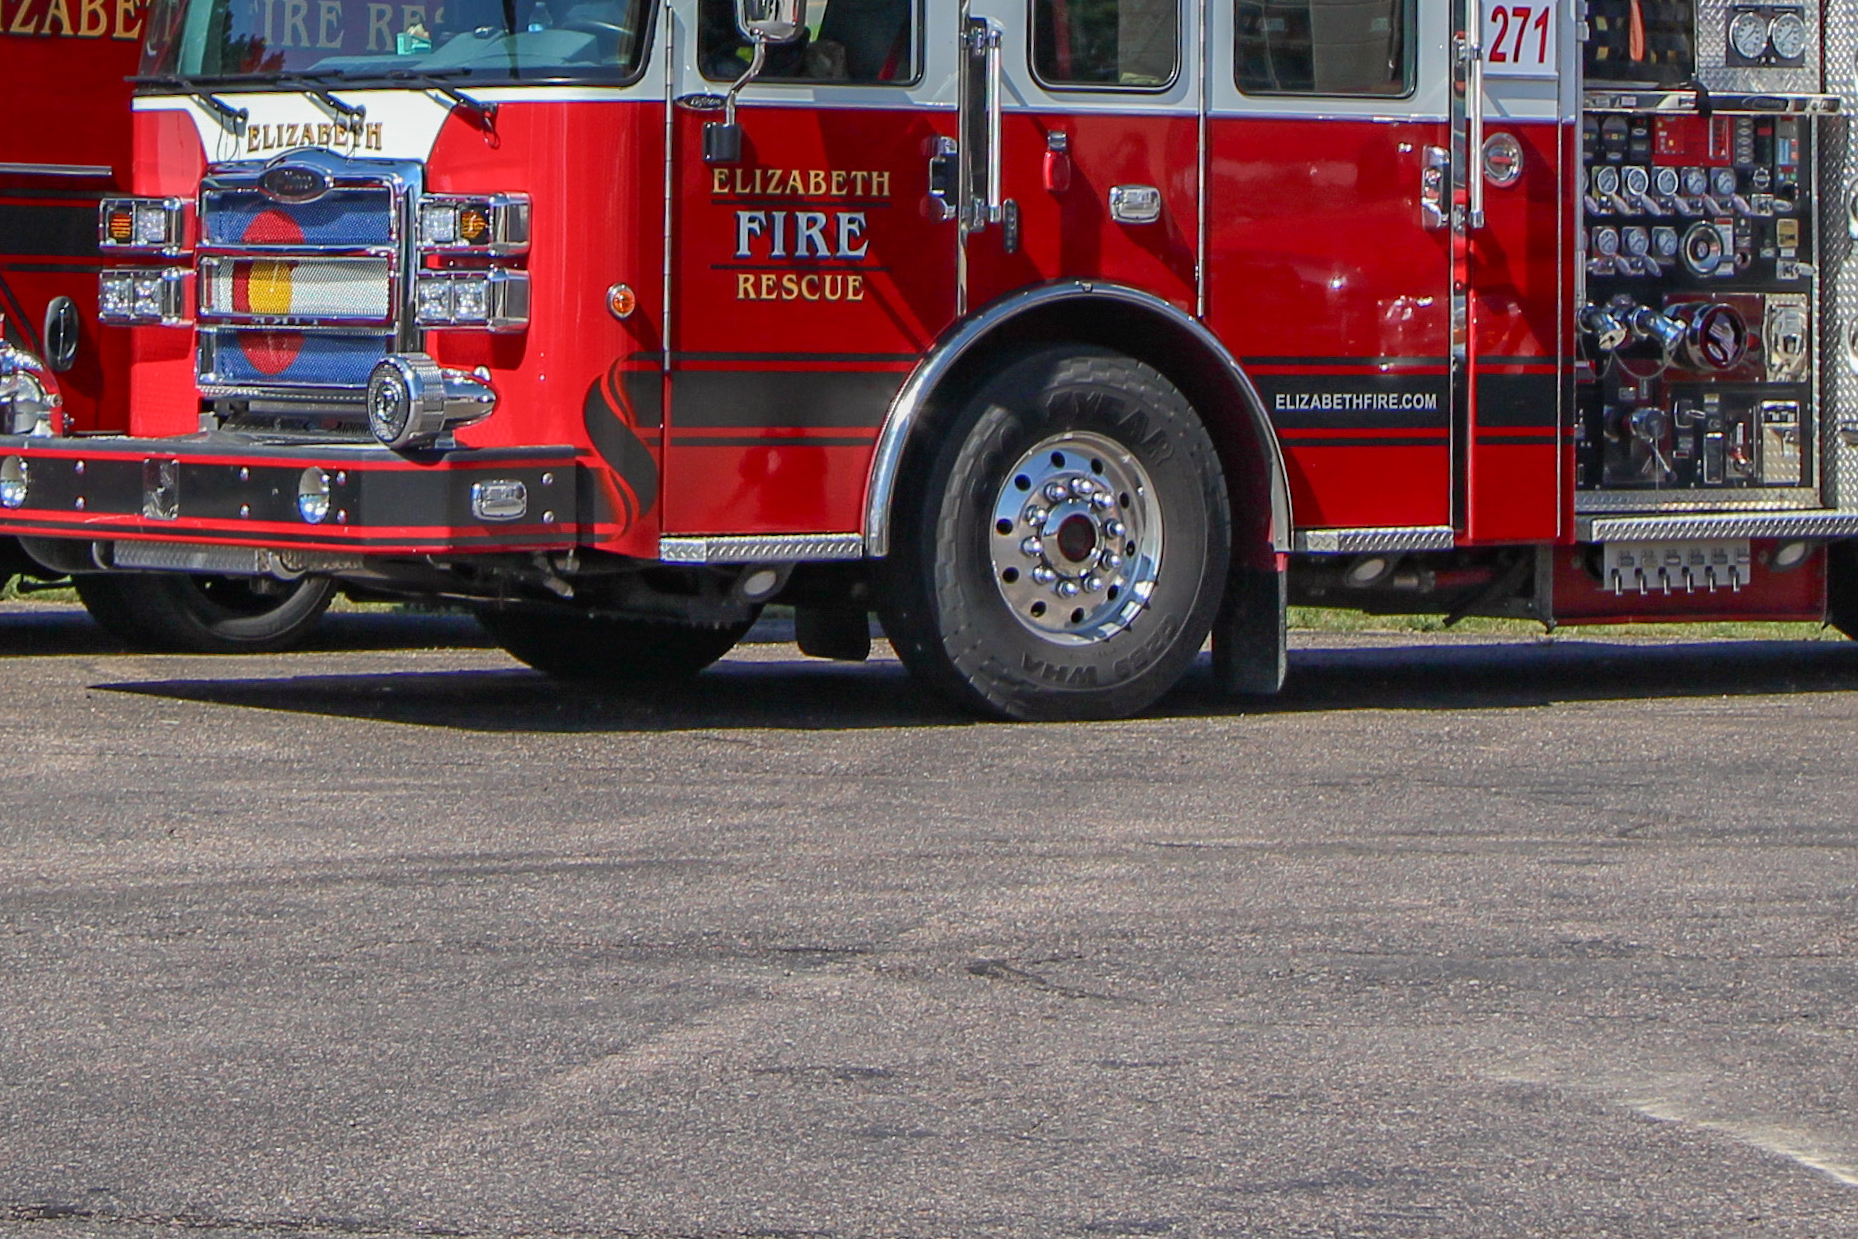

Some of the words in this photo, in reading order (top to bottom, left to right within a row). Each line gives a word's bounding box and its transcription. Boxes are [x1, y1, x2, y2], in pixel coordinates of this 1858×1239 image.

[1488, 5, 1550, 64] 271
[712, 168, 890, 196] ELIZABETH
[733, 210, 869, 260] FIRE
[736, 273, 864, 301] RESCUE
[1275, 393, 1437, 410] ELIZABETHFIRE.COM
